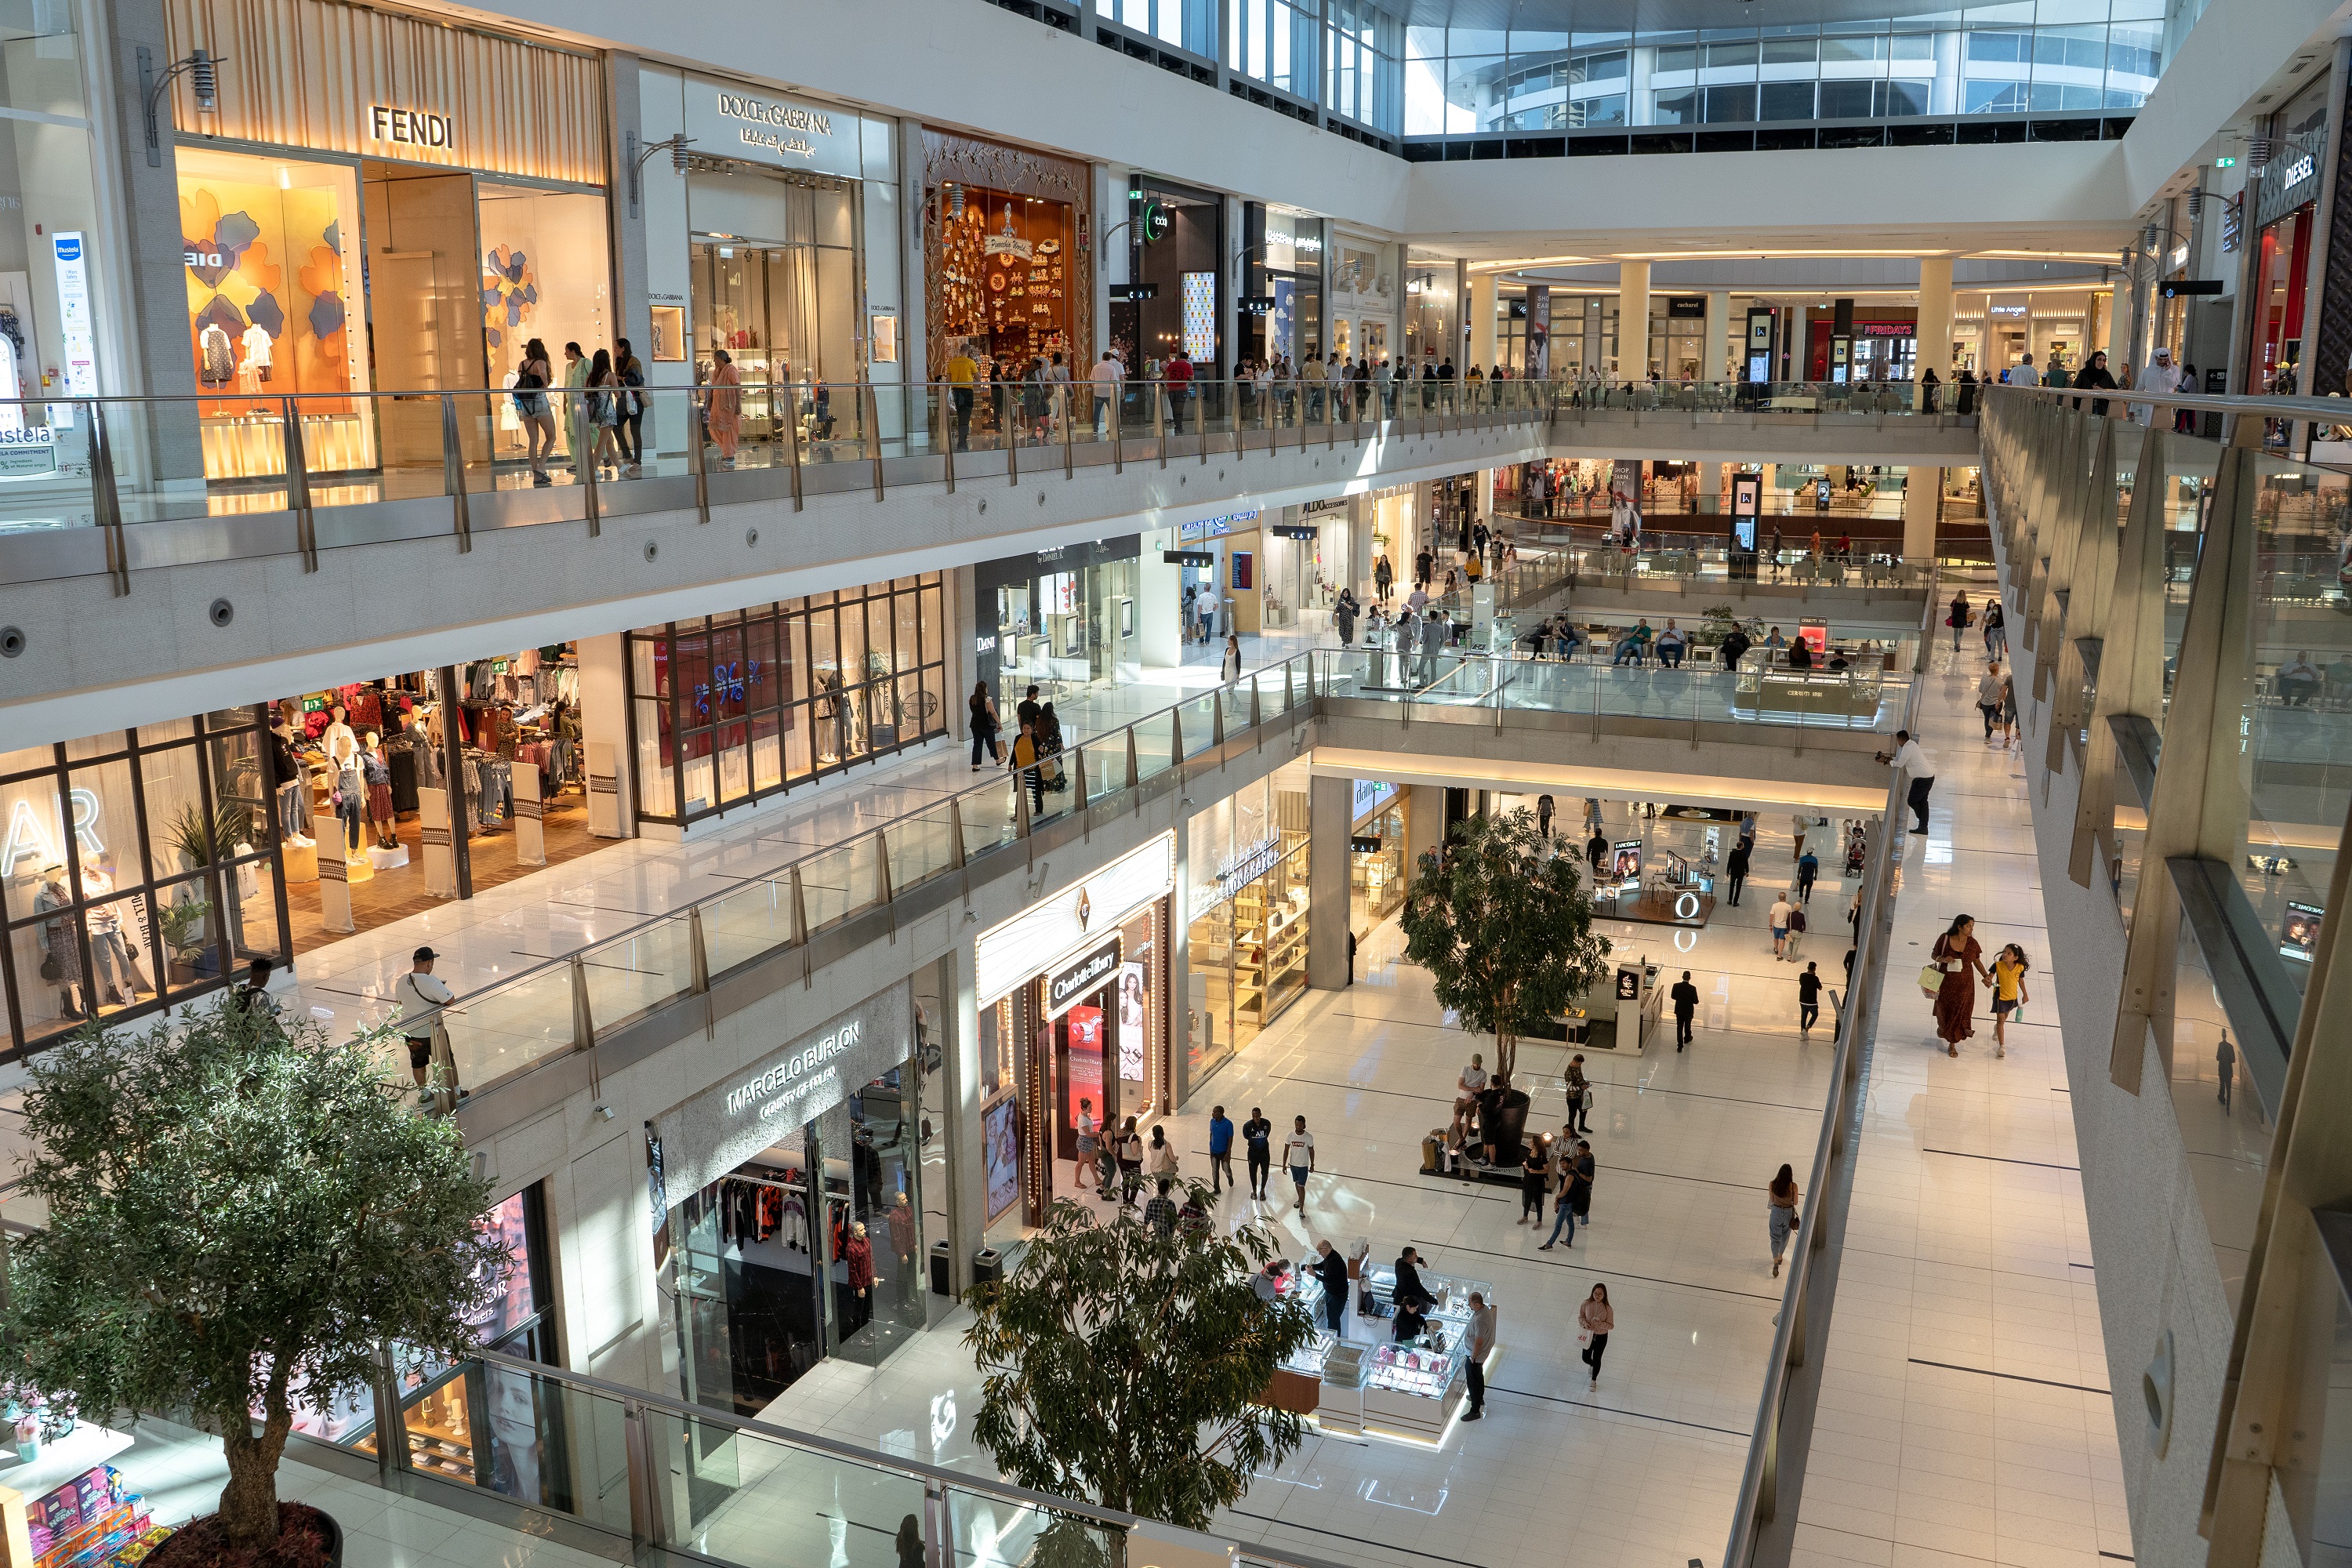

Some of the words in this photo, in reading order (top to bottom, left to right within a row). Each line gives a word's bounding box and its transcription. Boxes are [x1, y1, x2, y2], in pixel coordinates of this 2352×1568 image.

[372, 106, 452, 149] FENDI
[2285, 155, 2314, 191] DIESEL
[991, 238, 1011, 249] Pinocchio
[1012, 240, 1026, 252] World
[2005, 306, 2027, 317] Angels
[1870, 325, 1912, 335] FRIDAYS
[1303, 499, 1325, 514] ALDO
[1324, 499, 1348, 510] ACCESSORIES
[1214, 526, 1231, 535] EXCHANGE
[1037, 555, 1043, 565] by
[977, 636, 996, 652] DANI
[140, 924, 152, 950] BEAR
[728, 1055, 804, 1116] MARCELO
[803, 1020, 861, 1071] BURLON
[760, 1088, 797, 1120] COUNTY
[797, 1082, 811, 1098] OF
[810, 1065, 837, 1091] MILAN
